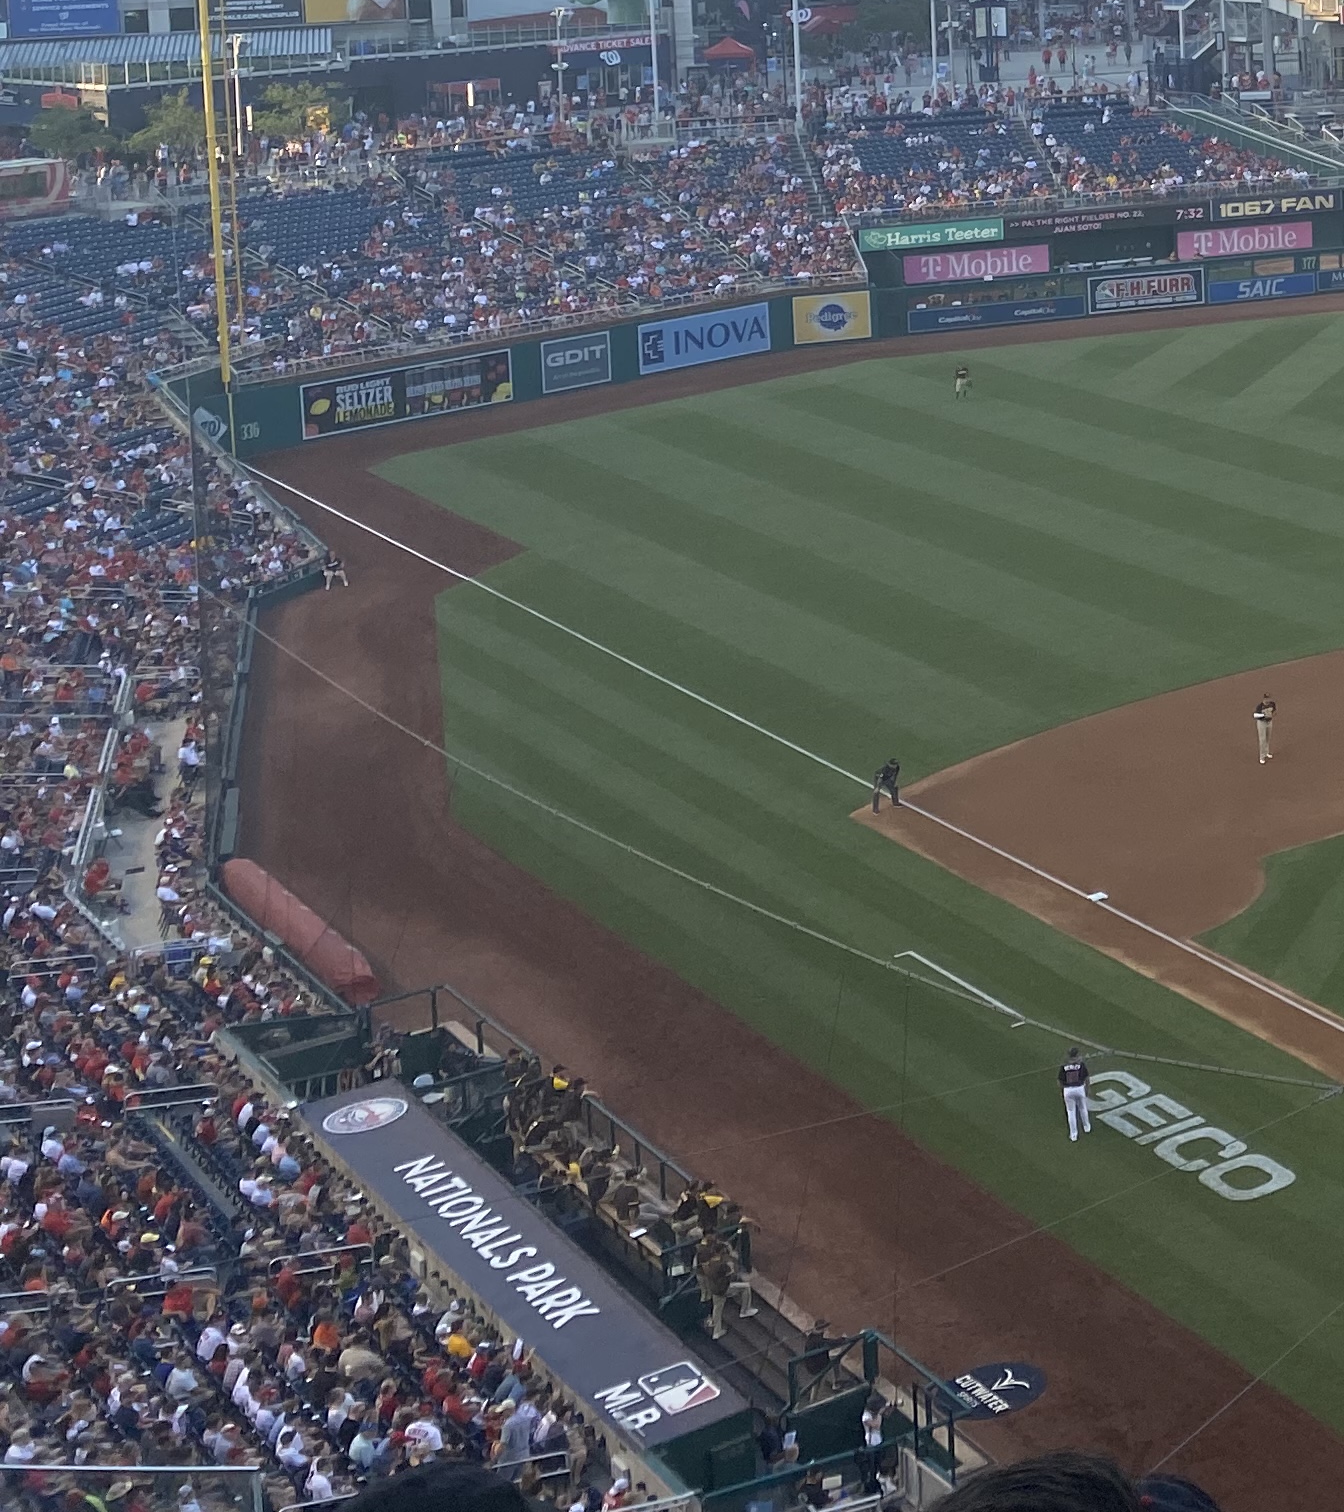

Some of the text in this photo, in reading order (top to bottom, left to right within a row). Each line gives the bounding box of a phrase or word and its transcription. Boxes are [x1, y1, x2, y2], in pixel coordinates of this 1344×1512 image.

[599, 39, 627, 50] TICKET
[1175, 207, 1204, 221] 7:32
[1281, 194, 1334, 215] FAN
[1055, 215, 1079, 225] RIGHT
[886, 225, 998, 247] Harris Teeter
[1218, 224, 1297, 253] Mobile
[947, 250, 1033, 279] Mobile
[1237, 278, 1286, 299] SAIC
[674, 316, 768, 356] INOVA
[546, 344, 607, 368] GDIT
[336, 385, 394, 411] SELTZER
[1087, 1070, 1296, 1201] GEICO
[394, 1154, 600, 1329] NATIONALS PARK
[955, 1374, 1009, 1414] CUTWATER
[594, 1382, 661, 1437] MLB
